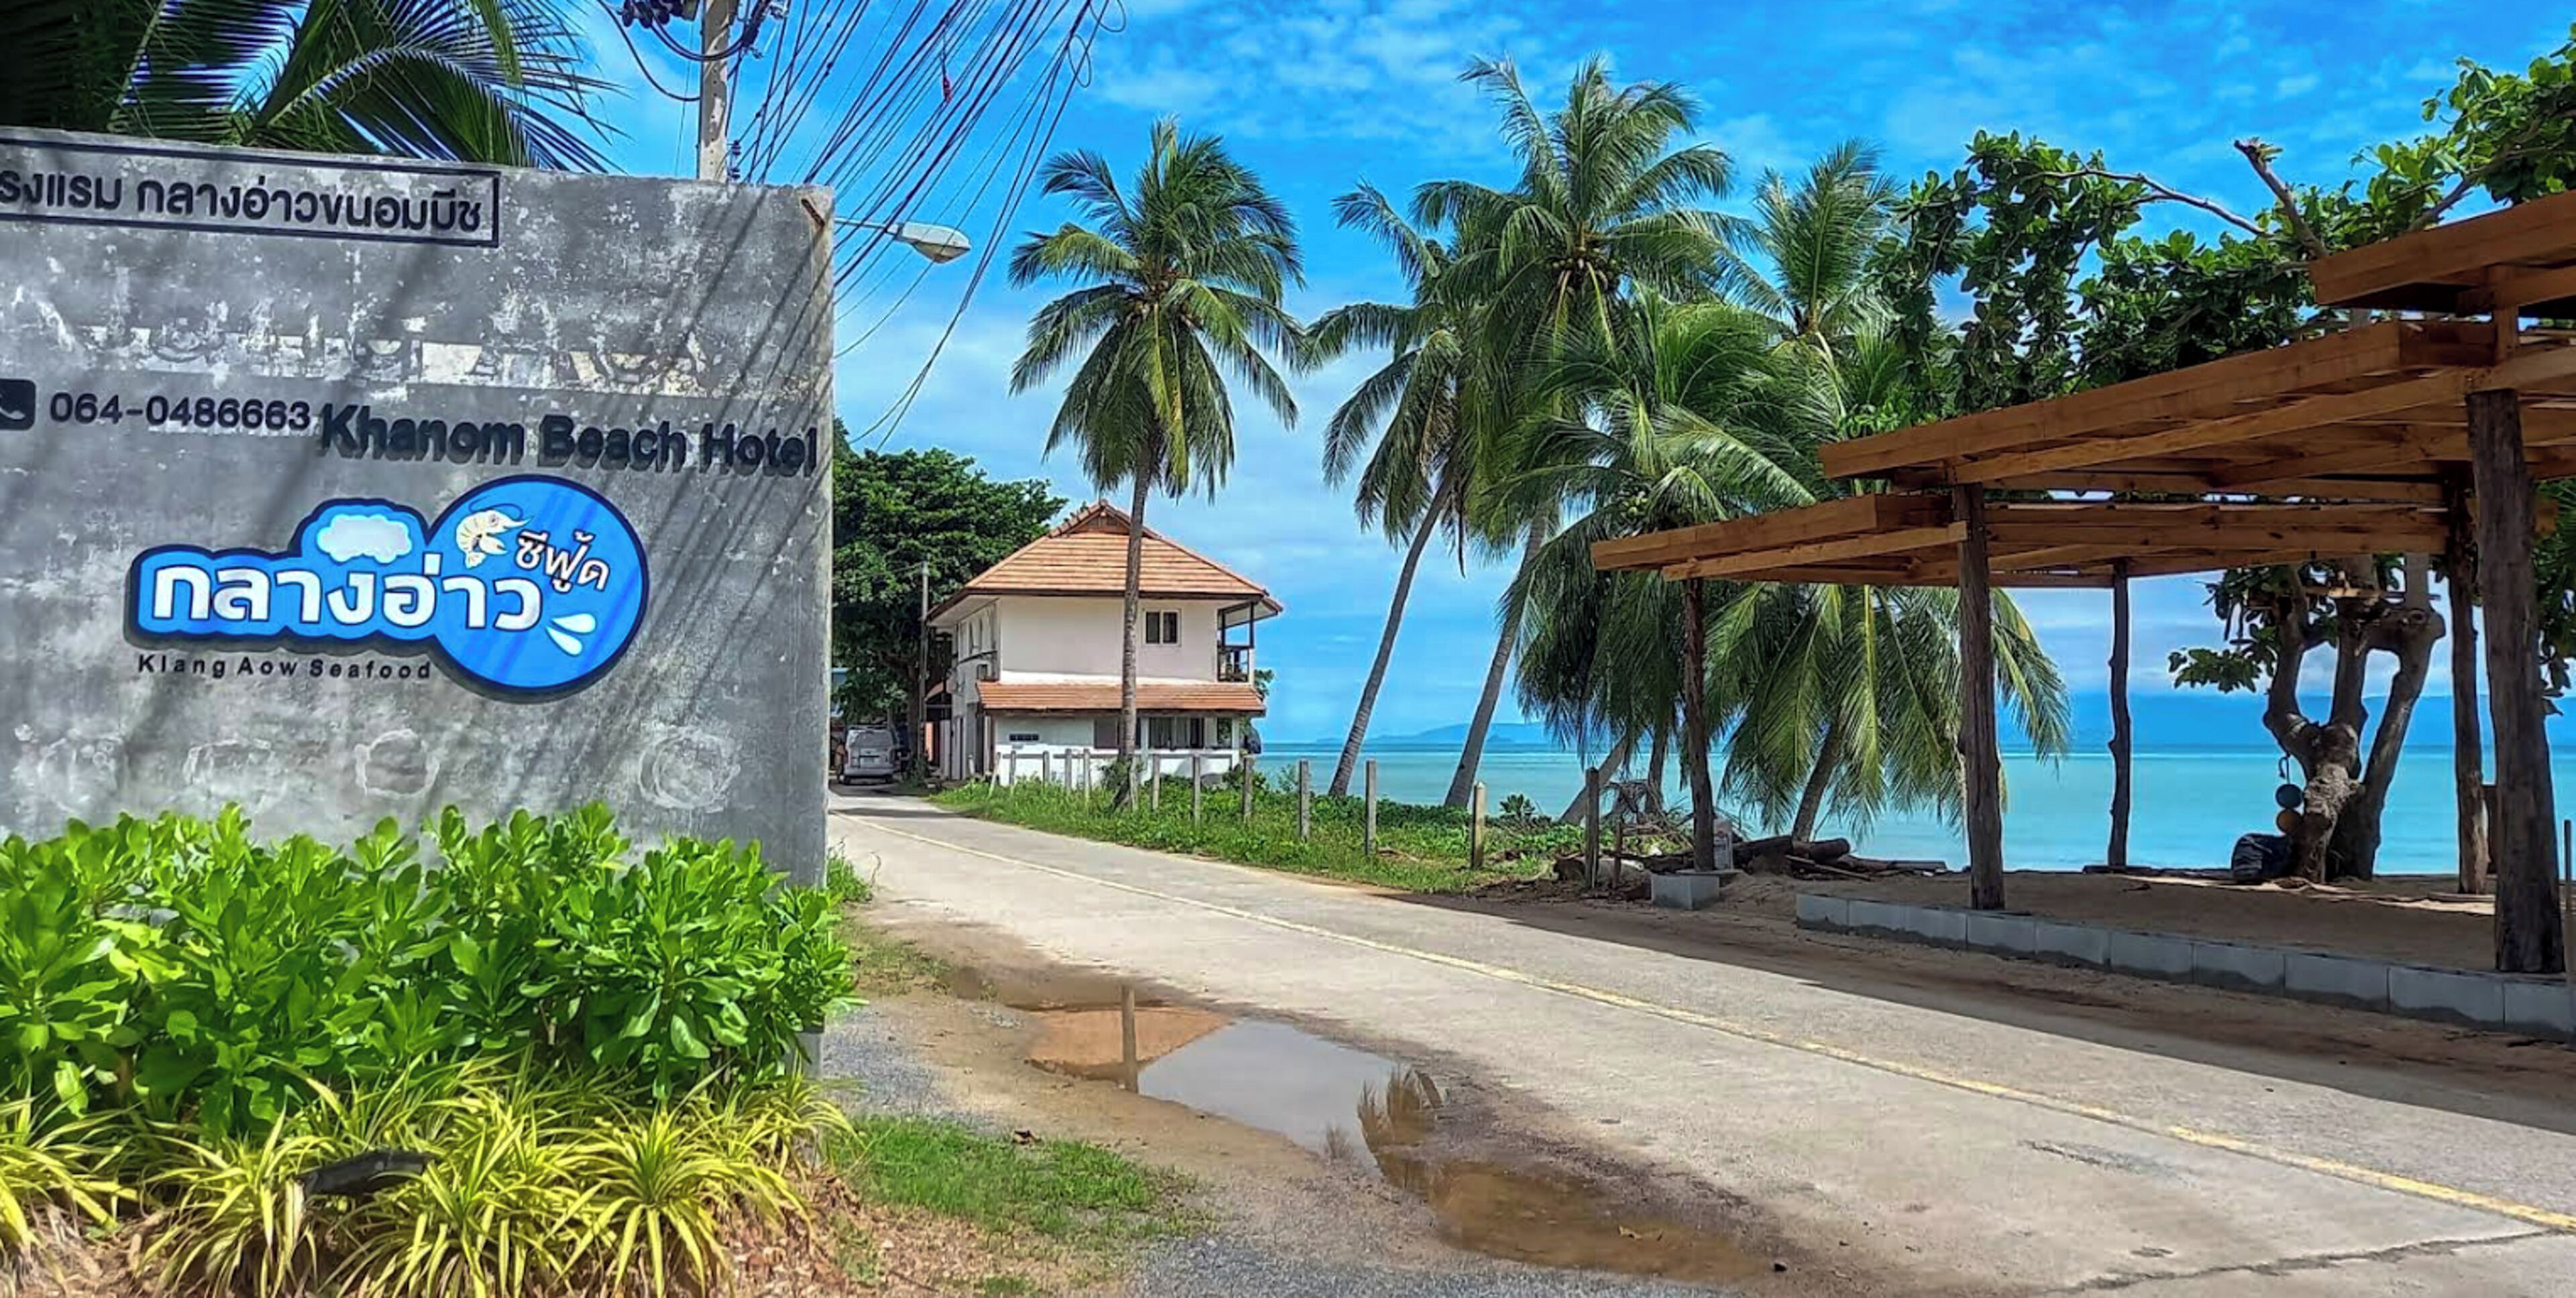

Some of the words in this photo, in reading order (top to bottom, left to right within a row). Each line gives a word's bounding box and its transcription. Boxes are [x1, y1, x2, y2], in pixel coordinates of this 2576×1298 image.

[136, 176, 481, 232] กลางอ่าวขนอมบีช
[49, 392, 311, 430] 064-0486663
[318, 404, 525, 464] Khanom
[539, 414, 686, 472] Beach
[701, 423, 817, 476] Hotel
[152, 553, 543, 631] กลางอ่าว
[138, 655, 226, 678] Klang
[237, 657, 297, 675] Aow
[309, 659, 431, 678] Seafood
